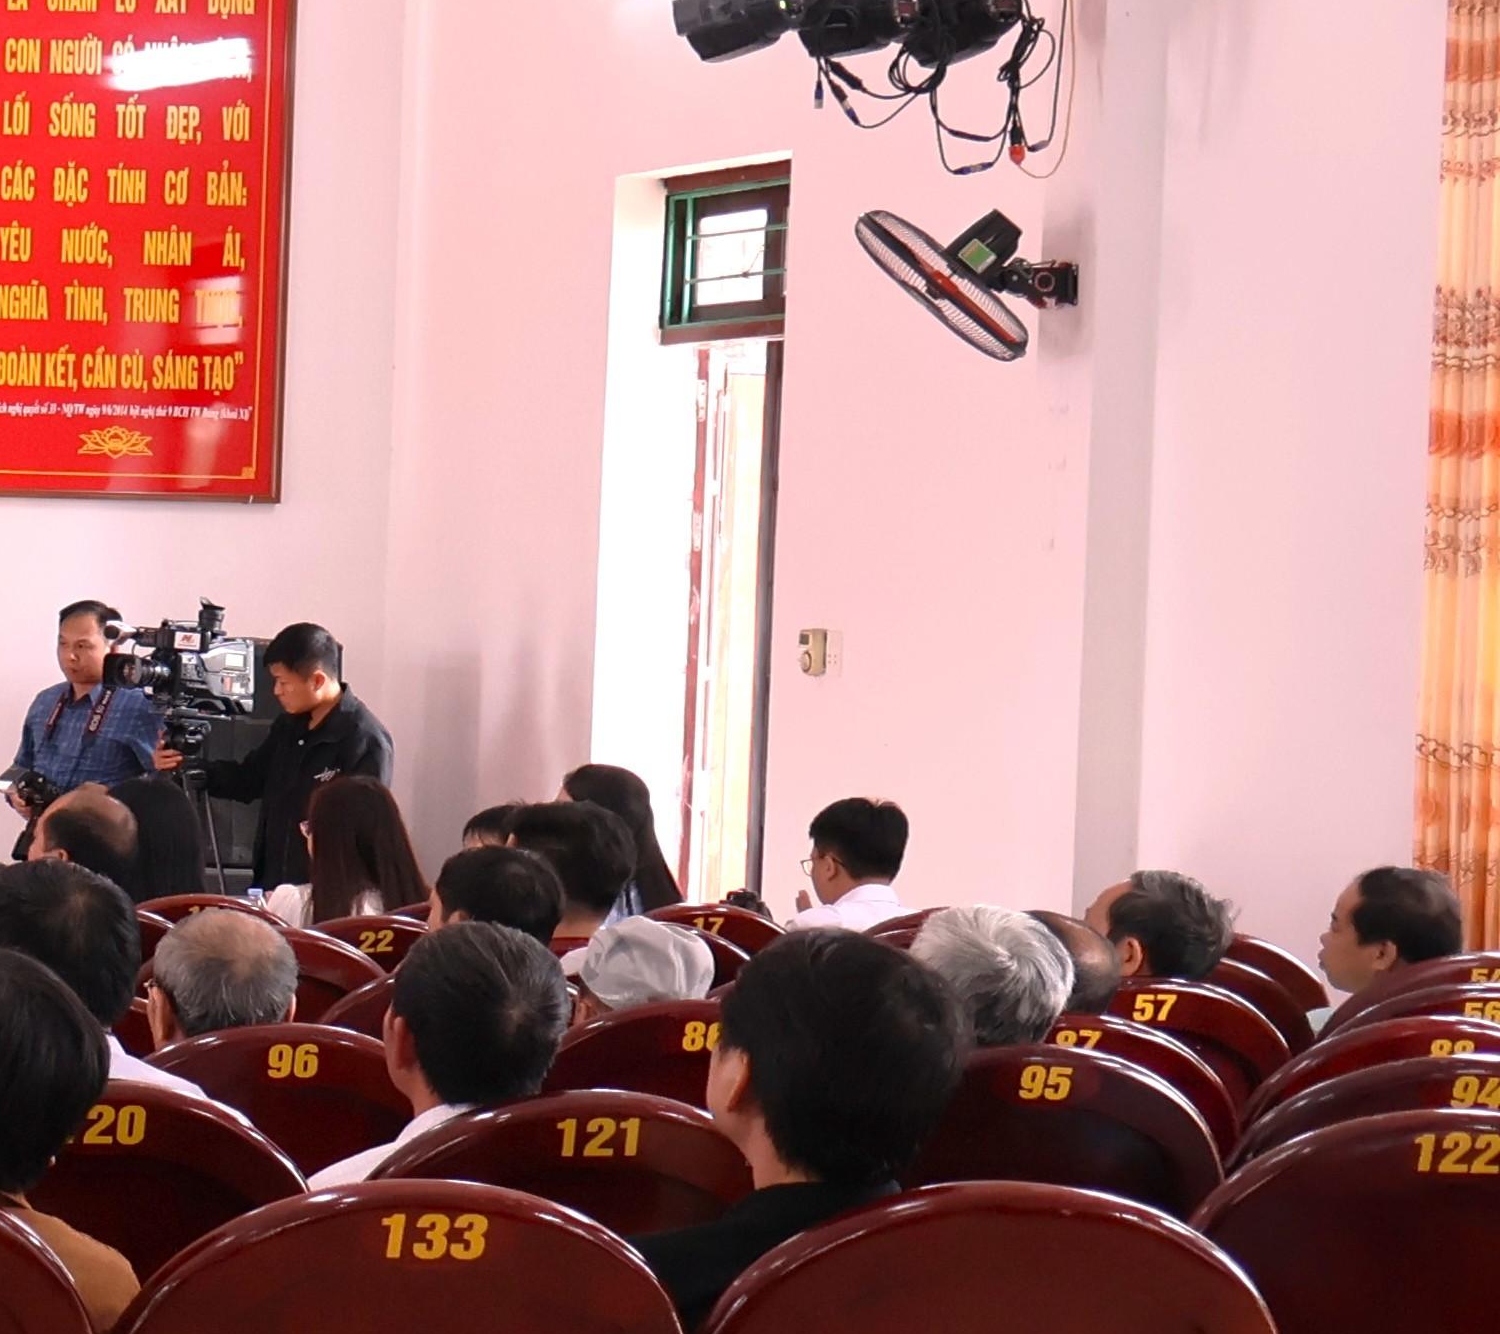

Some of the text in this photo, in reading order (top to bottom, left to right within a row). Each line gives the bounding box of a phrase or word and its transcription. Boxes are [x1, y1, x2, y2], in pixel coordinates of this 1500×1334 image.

[359, 930, 394, 954] 22
[1133, 994, 1177, 1021] 57
[268, 1044, 318, 1078] 96
[1019, 1066, 1073, 1100] 95
[557, 1118, 640, 1156] 121
[1414, 1132, 1500, 1174] 122
[382, 1214, 488, 1259] 133
